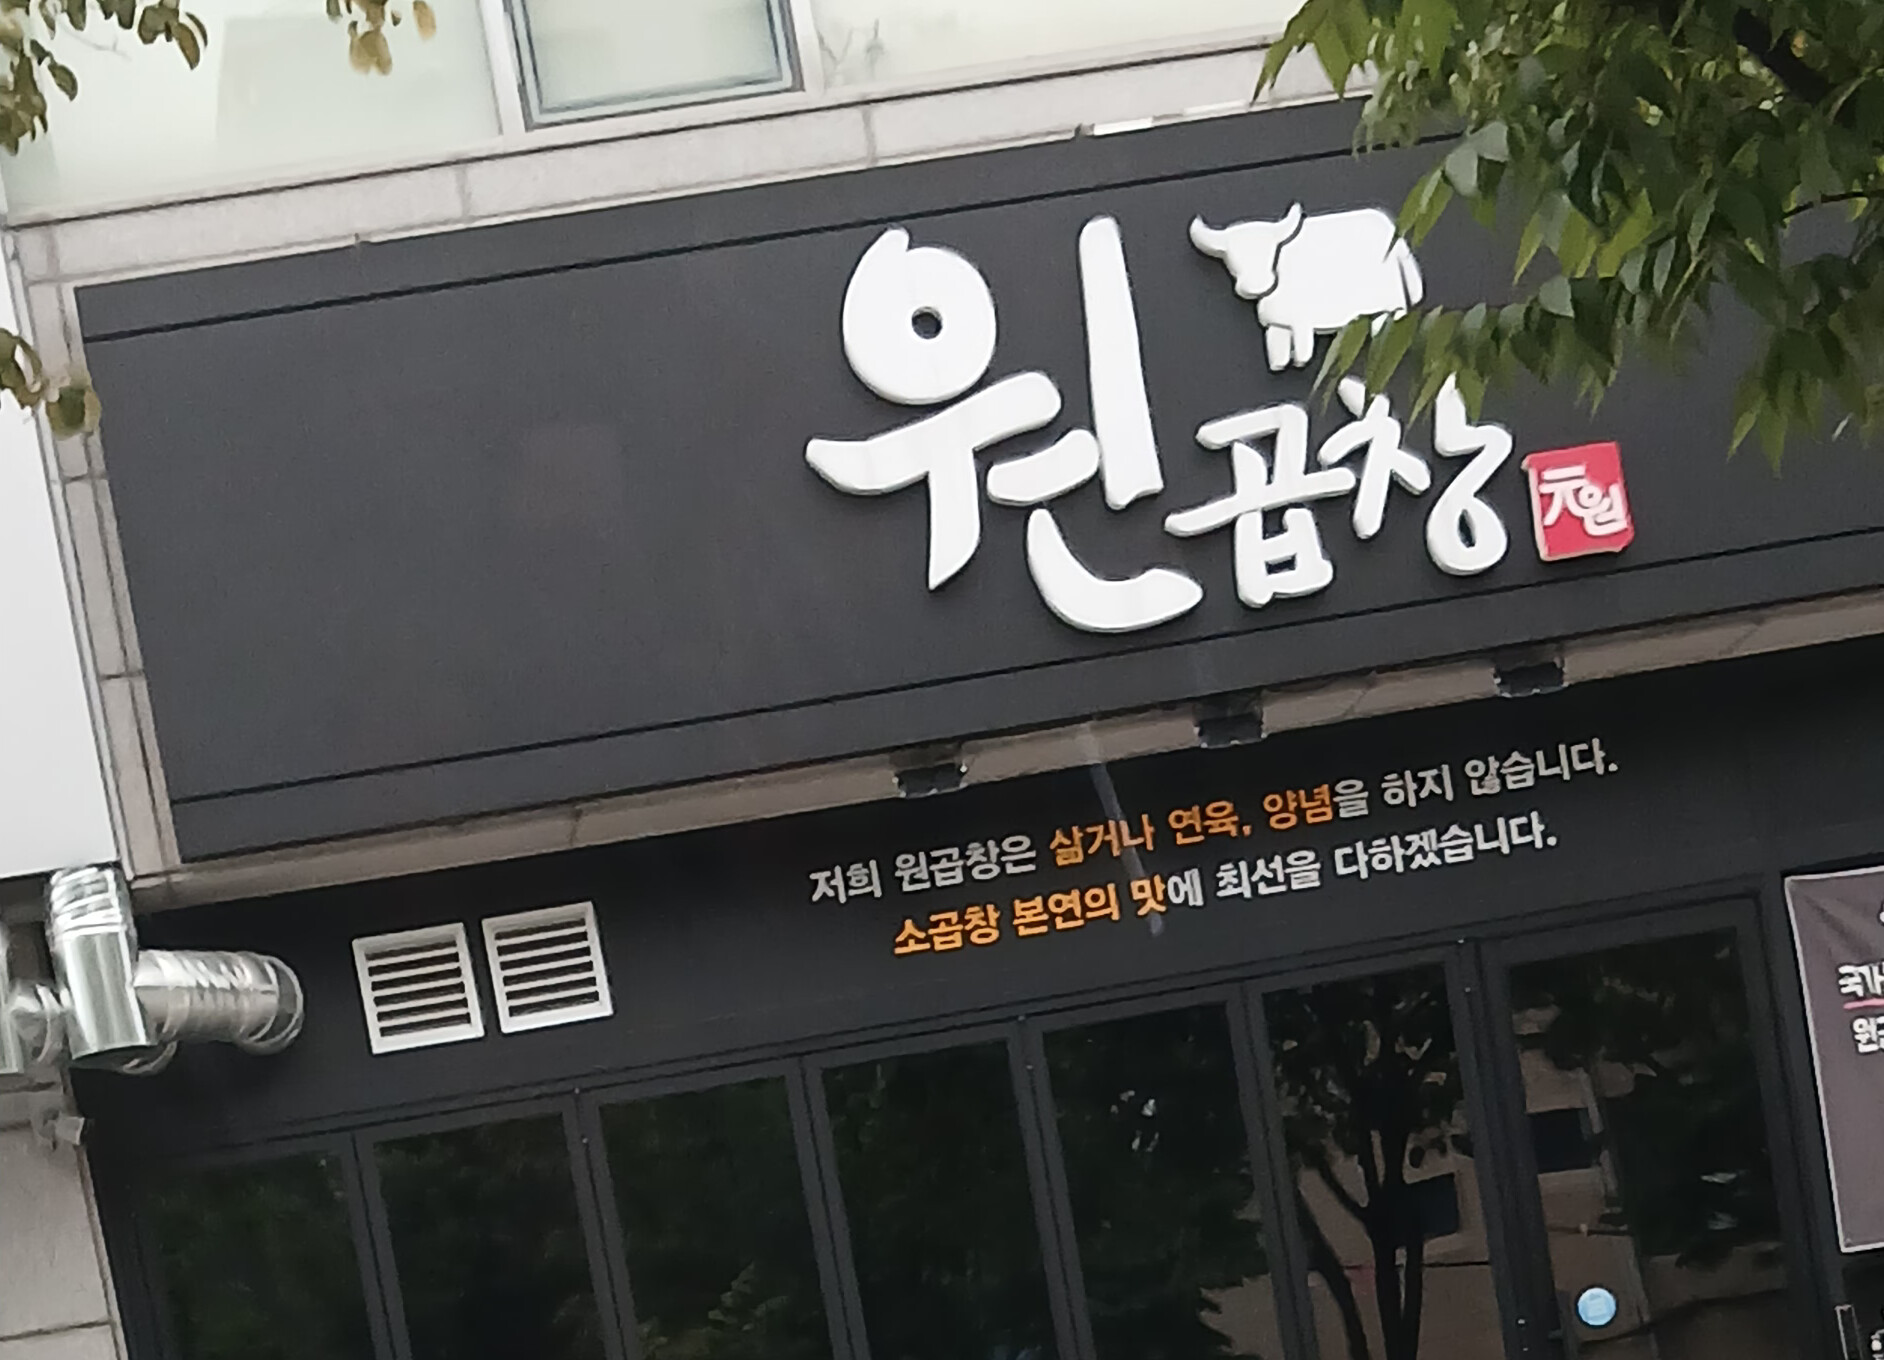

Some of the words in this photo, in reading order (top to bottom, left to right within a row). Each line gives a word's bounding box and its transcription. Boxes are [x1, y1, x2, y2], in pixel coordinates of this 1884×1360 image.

[810, 859, 883, 903] 저희
[895, 834, 1037, 892] 원곱창은
[1049, 814, 1154, 866] 삶거나
[1168, 799, 1252, 845] 연육,
[1263, 778, 1370, 830] 양념을
[1381, 764, 1454, 808] 하지
[1464, 737, 1619, 796] 않습니다.
[894, 904, 1000, 955] 소곱창
[1012, 883, 1120, 937] 본연의
[1130, 868, 1204, 917] 맛에
[1216, 848, 1322, 899] 최선을
[1334, 810, 1558, 880] 다하겠습니다.
